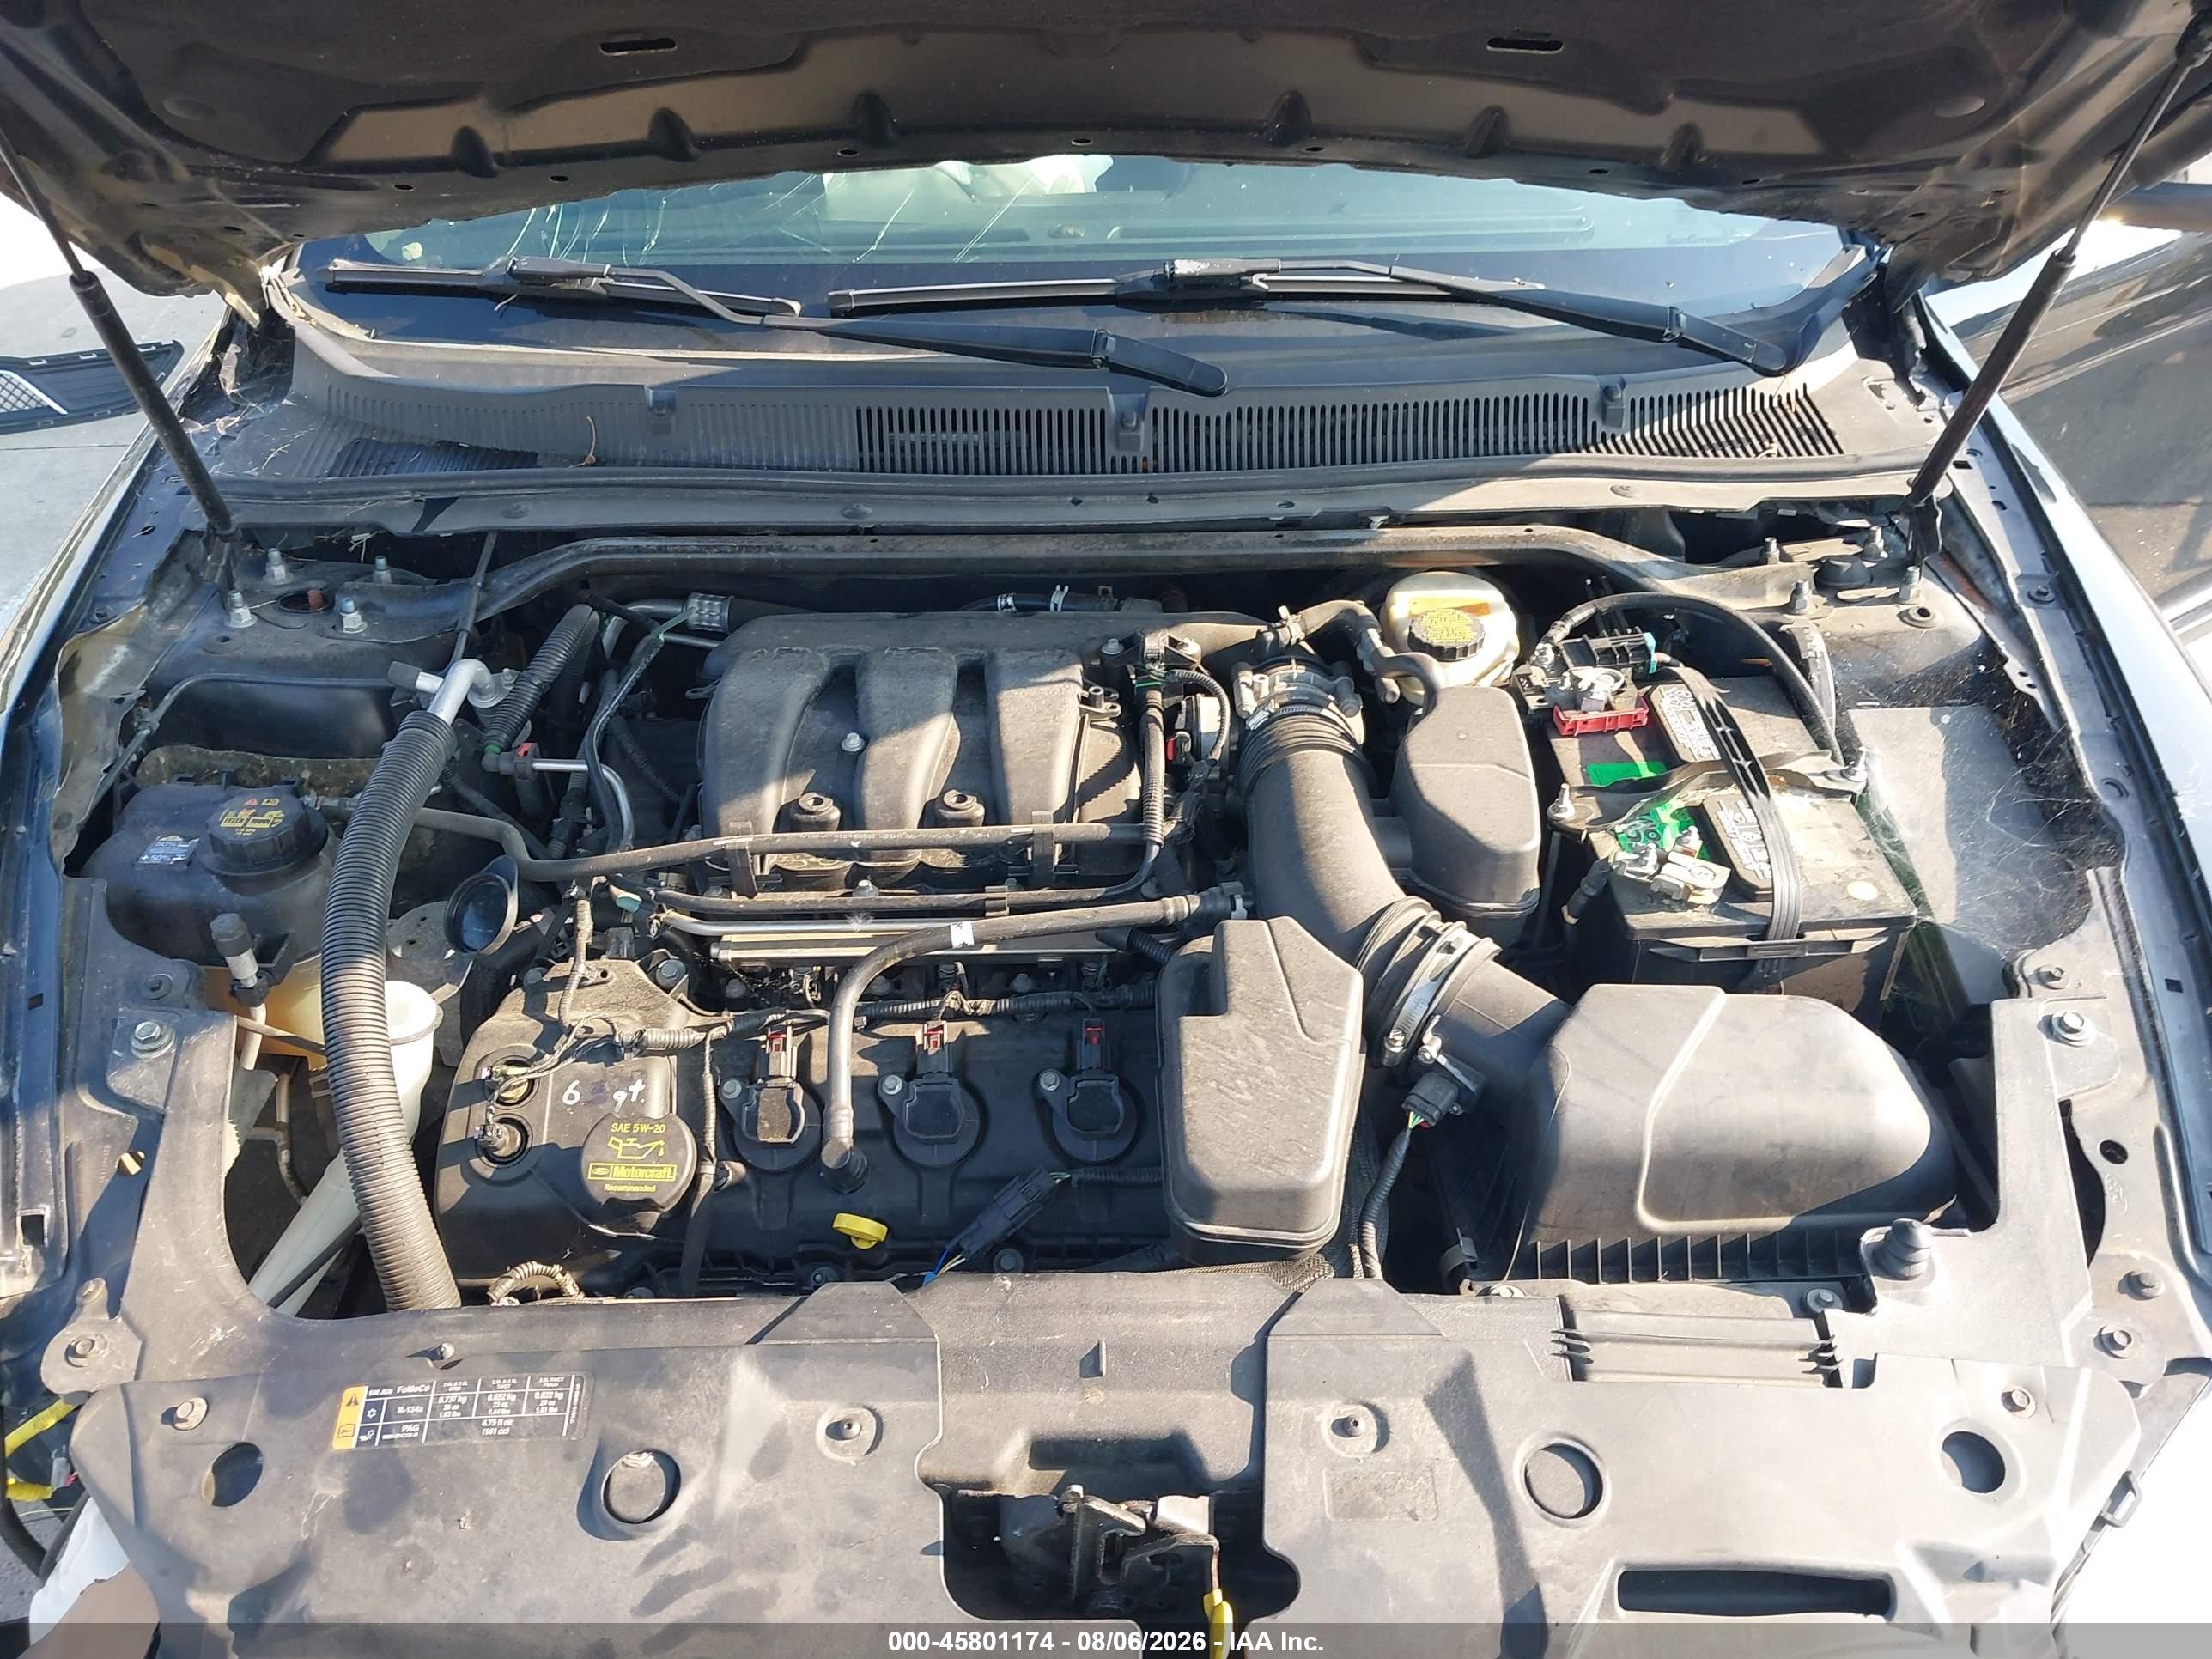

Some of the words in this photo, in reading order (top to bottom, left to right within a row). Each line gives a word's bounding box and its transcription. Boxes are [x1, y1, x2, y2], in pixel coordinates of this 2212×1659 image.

[562, 1079, 581, 1105] 6
[611, 1122, 630, 1133] SAE
[632, 1123, 666, 1134] 5W-20
[613, 1165, 673, 1179] Motorcraft
[604, 1184, 656, 1193] Recommended
[396, 1385, 431, 1394] FoMoCo
[401, 1424, 420, 1432] PAG
